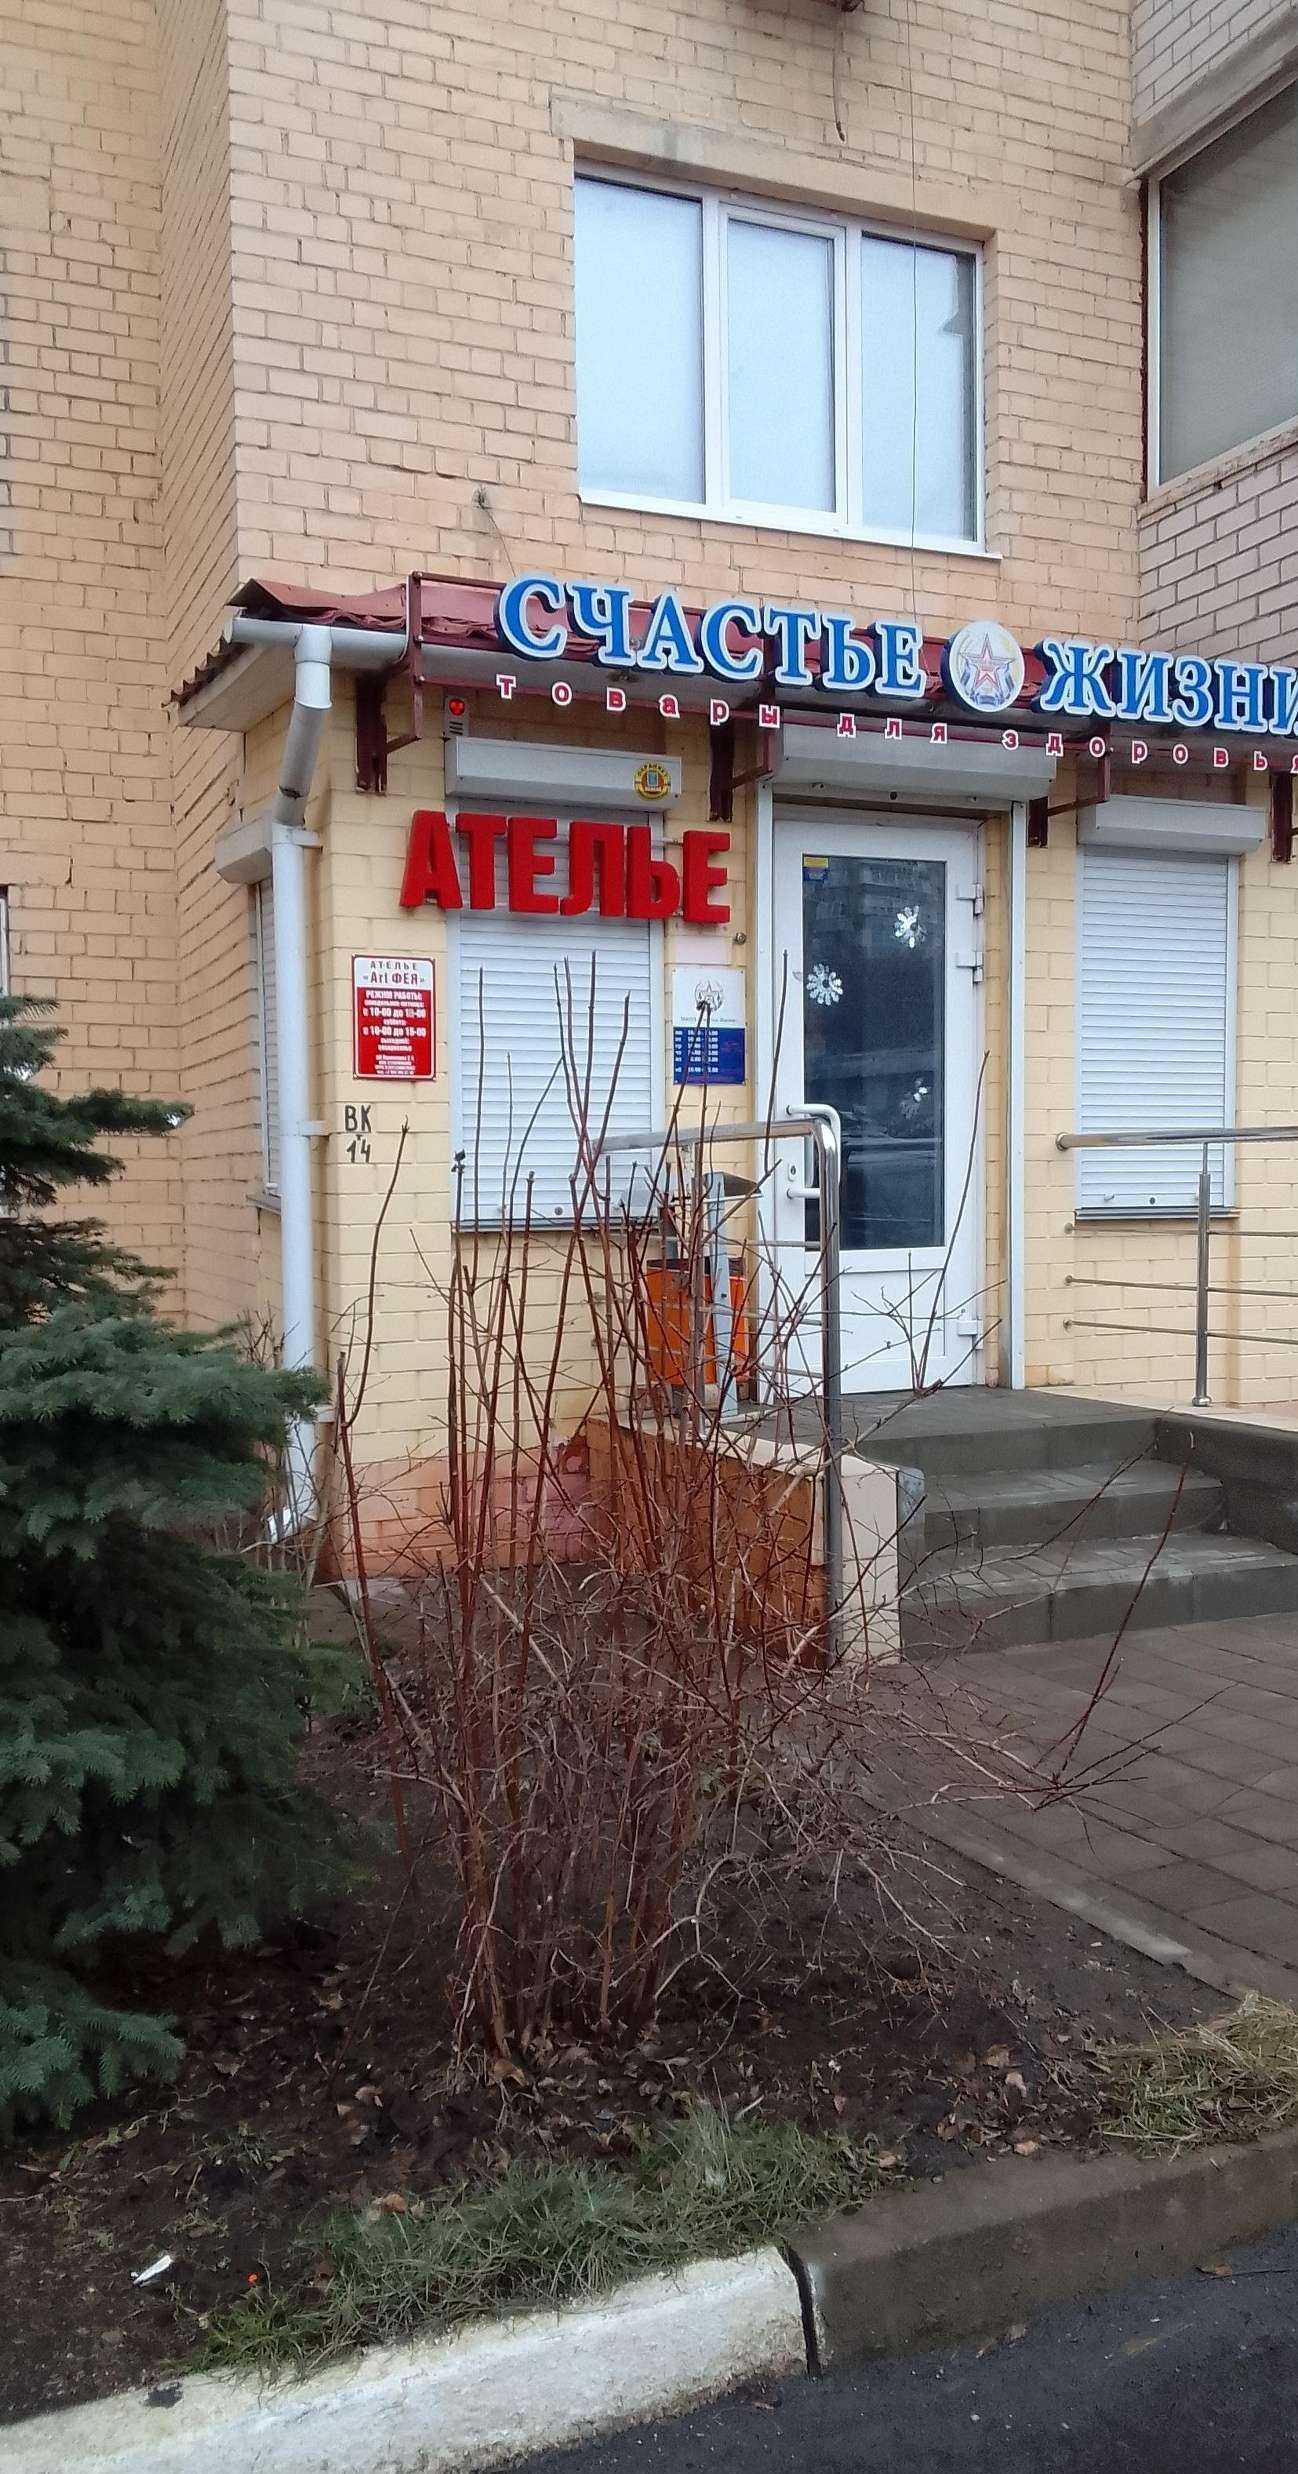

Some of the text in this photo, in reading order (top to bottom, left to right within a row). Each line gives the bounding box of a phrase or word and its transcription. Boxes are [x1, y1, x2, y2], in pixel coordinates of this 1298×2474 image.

[499, 573, 927, 698] СЧАСТЬЕ
[496, 673, 780, 729] товары
[837, 713, 949, 744] для
[400, 809, 731, 925] АТЕЛЬЕ
[370, 960, 417, 970] АТЕЛЬЕ
